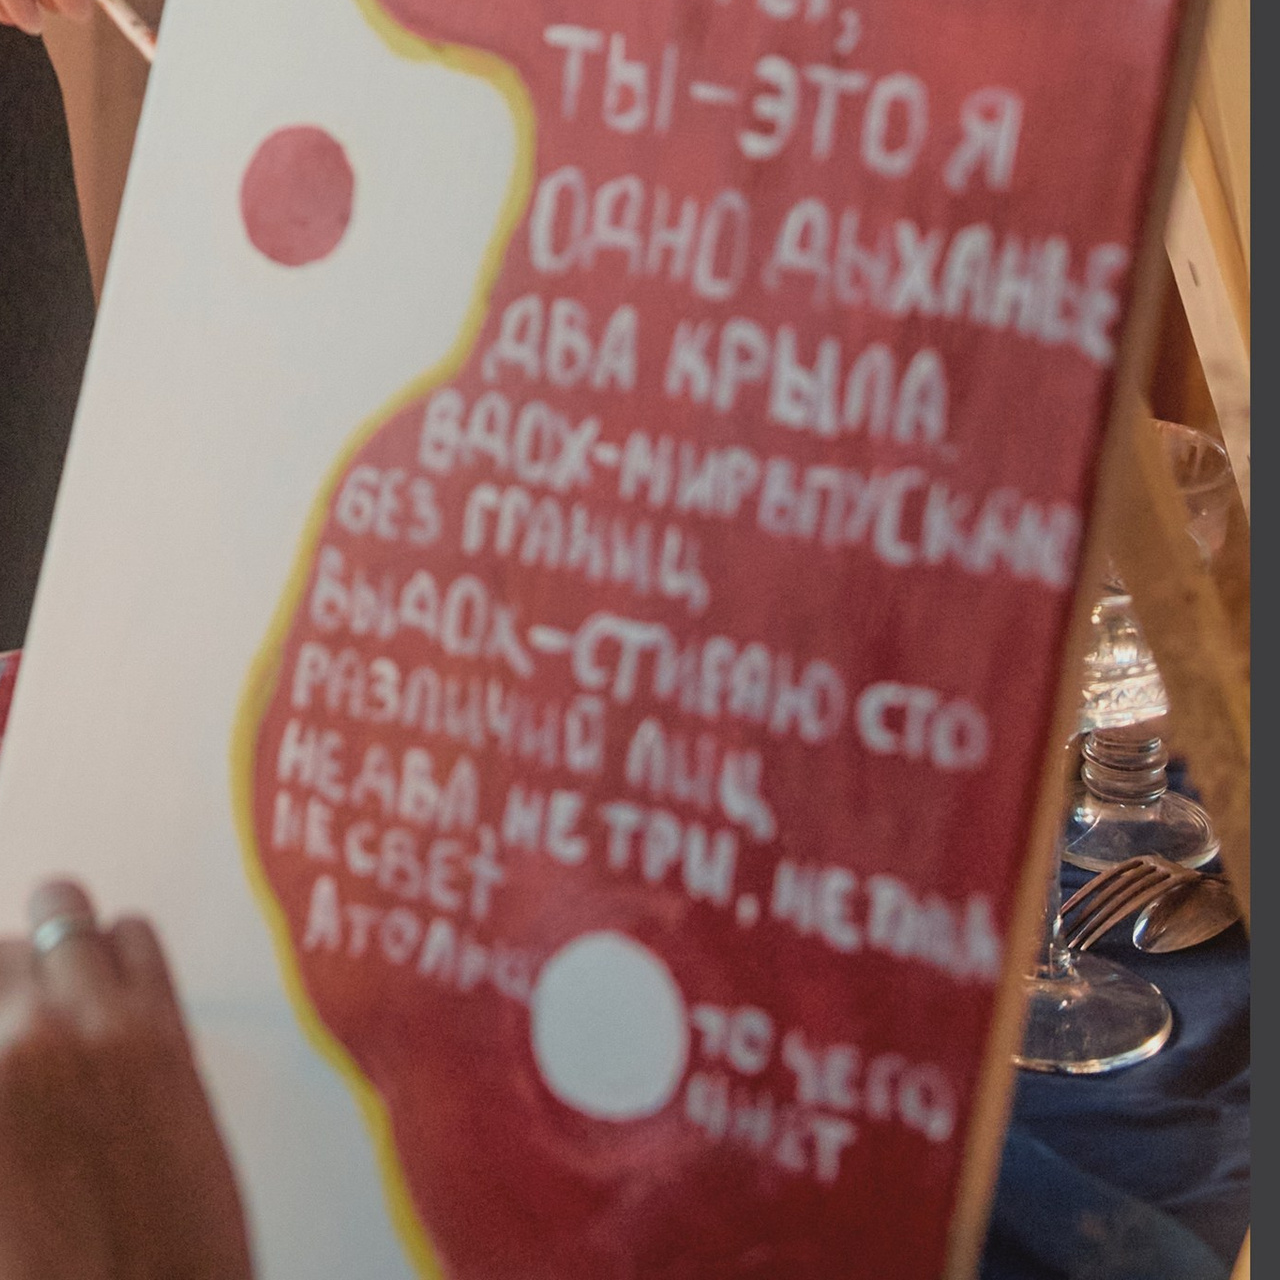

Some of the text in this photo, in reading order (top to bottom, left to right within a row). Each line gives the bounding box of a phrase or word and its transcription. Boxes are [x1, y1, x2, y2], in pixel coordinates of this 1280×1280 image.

[942, 85, 1024, 193] Я
[528, 165, 751, 301] ОДНО
[481, 293, 639, 392] ДВА
[335, 465, 713, 618] БЕЗ ГРАНИЦ
[625, 715, 776, 843] ЛИЦ
[856, 679, 990, 773] СТО
